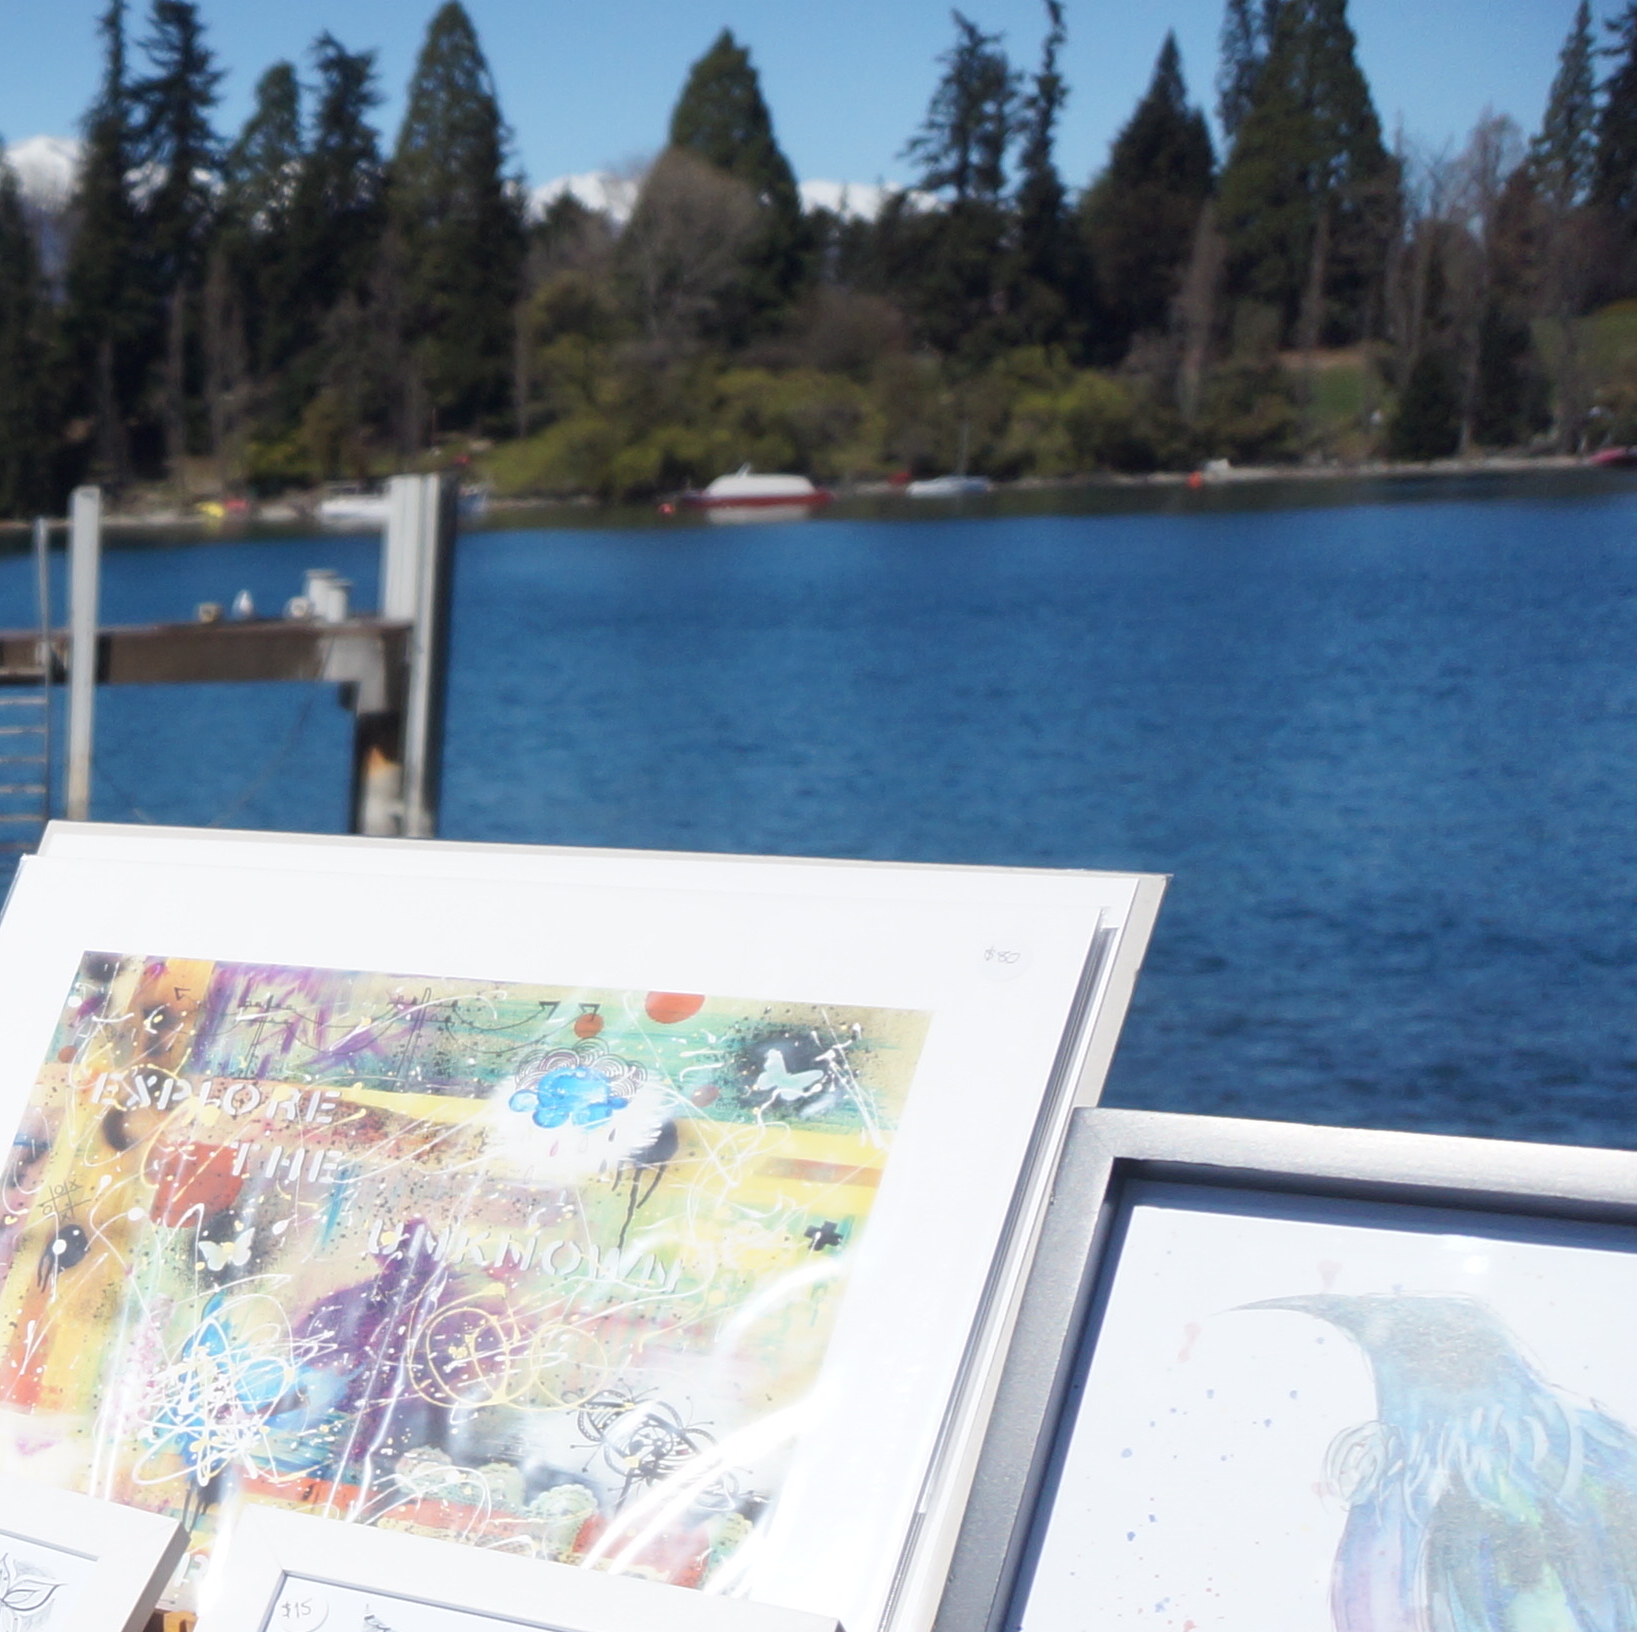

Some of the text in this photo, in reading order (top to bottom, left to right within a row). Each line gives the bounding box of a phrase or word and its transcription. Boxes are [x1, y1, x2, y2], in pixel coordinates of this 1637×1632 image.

[91, 1071, 341, 1128] EXPLORE
[227, 1141, 345, 1185] THE
[366, 1221, 687, 1292] UNKNOWN
[282, 1598, 313, 1619] $15
